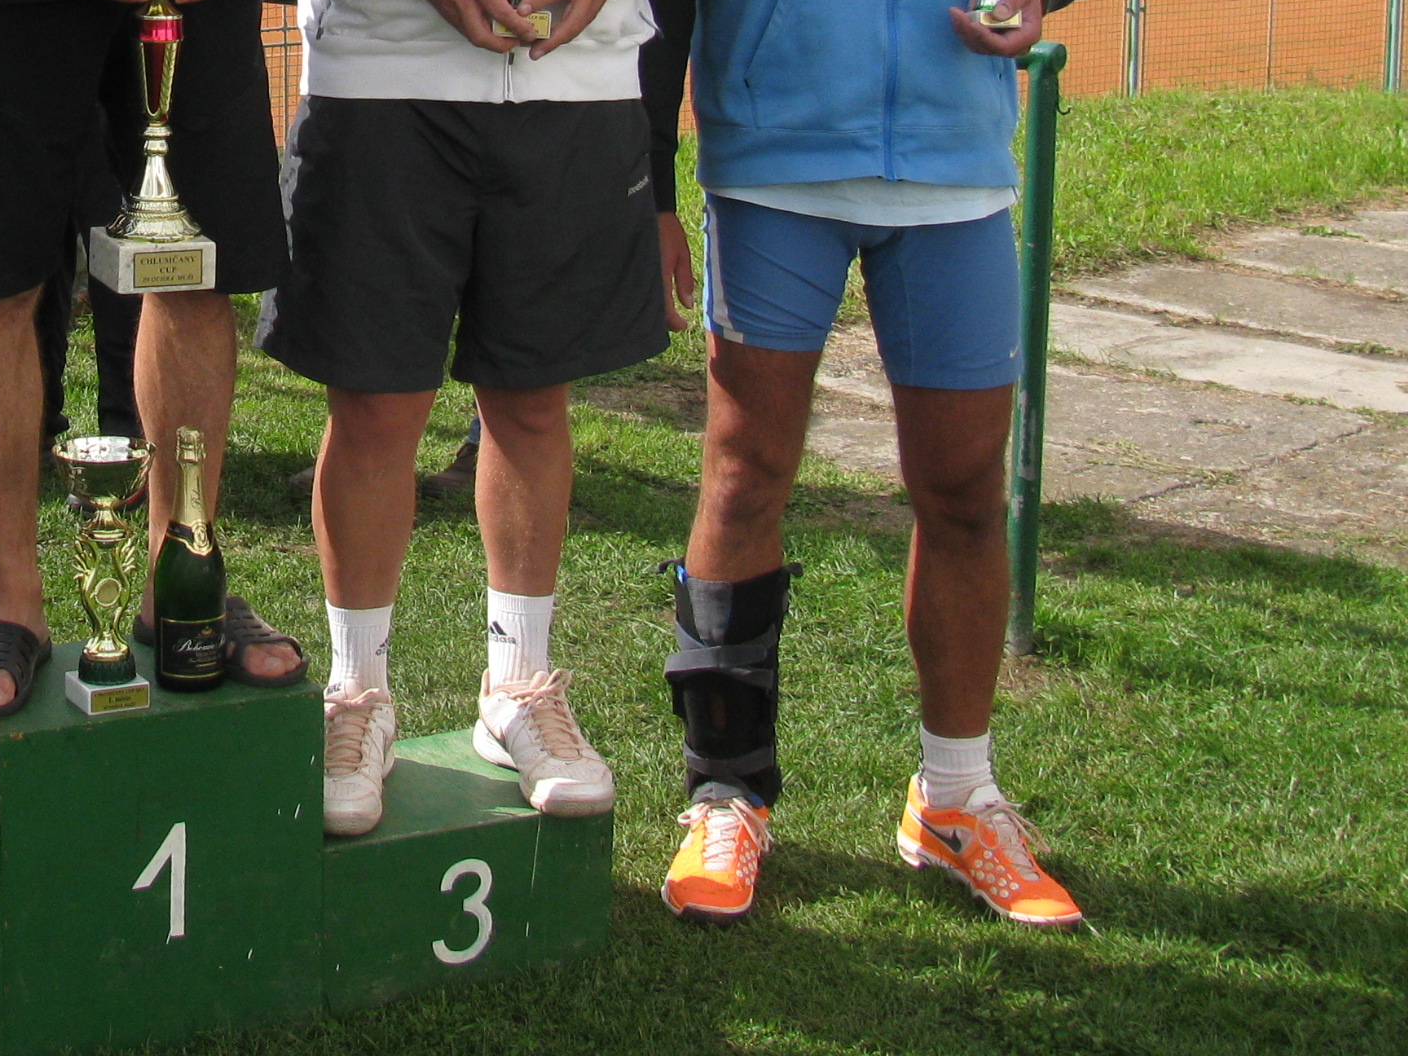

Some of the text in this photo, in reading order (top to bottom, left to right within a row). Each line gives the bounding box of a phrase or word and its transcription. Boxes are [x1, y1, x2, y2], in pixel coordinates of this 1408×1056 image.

[140, 254, 197, 265] CHLUMČANY
[159, 266, 177, 274] CUP
[132, 822, 186, 937] 1
[432, 858, 493, 965] 3
